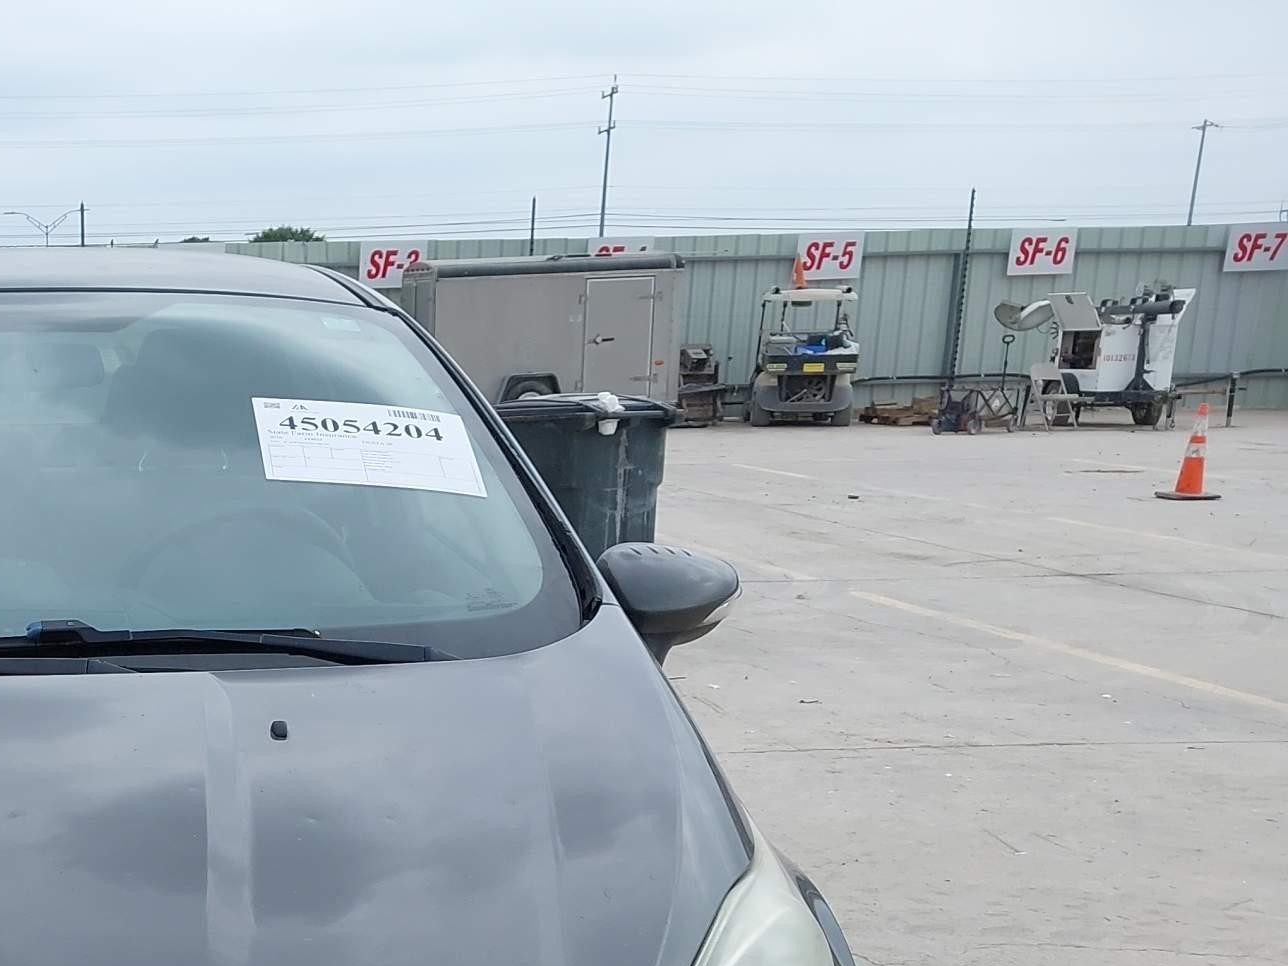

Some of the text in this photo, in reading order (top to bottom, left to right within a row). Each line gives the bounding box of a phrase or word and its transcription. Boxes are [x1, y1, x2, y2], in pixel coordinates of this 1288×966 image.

[802, 242, 856, 270] SF-5
[1016, 237, 1067, 267] SF-6
[1233, 233, 1287, 262] SF-7
[279, 415, 444, 442] 45054204
